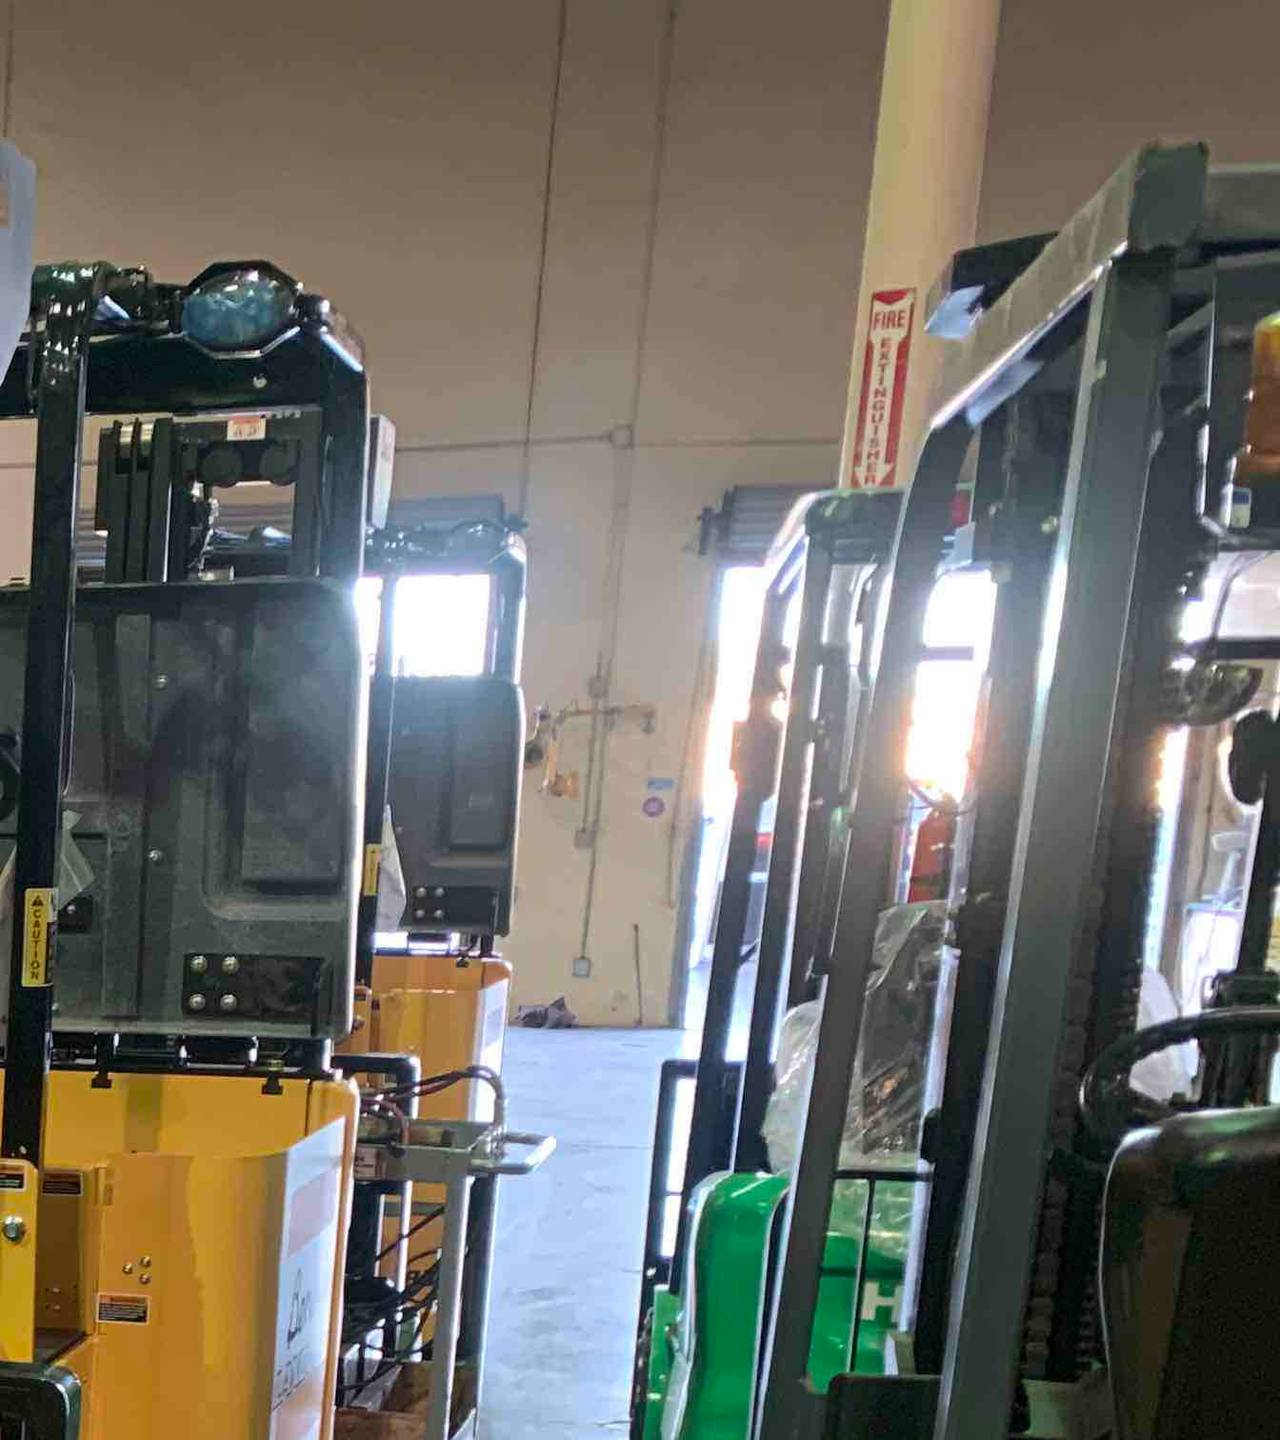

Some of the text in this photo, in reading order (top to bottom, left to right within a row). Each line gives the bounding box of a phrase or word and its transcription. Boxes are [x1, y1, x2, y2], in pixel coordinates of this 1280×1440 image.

[872, 310, 906, 330] FIRE
[864, 337, 893, 486] EXTINGUISHER
[30, 908, 43, 981] CAUTION
